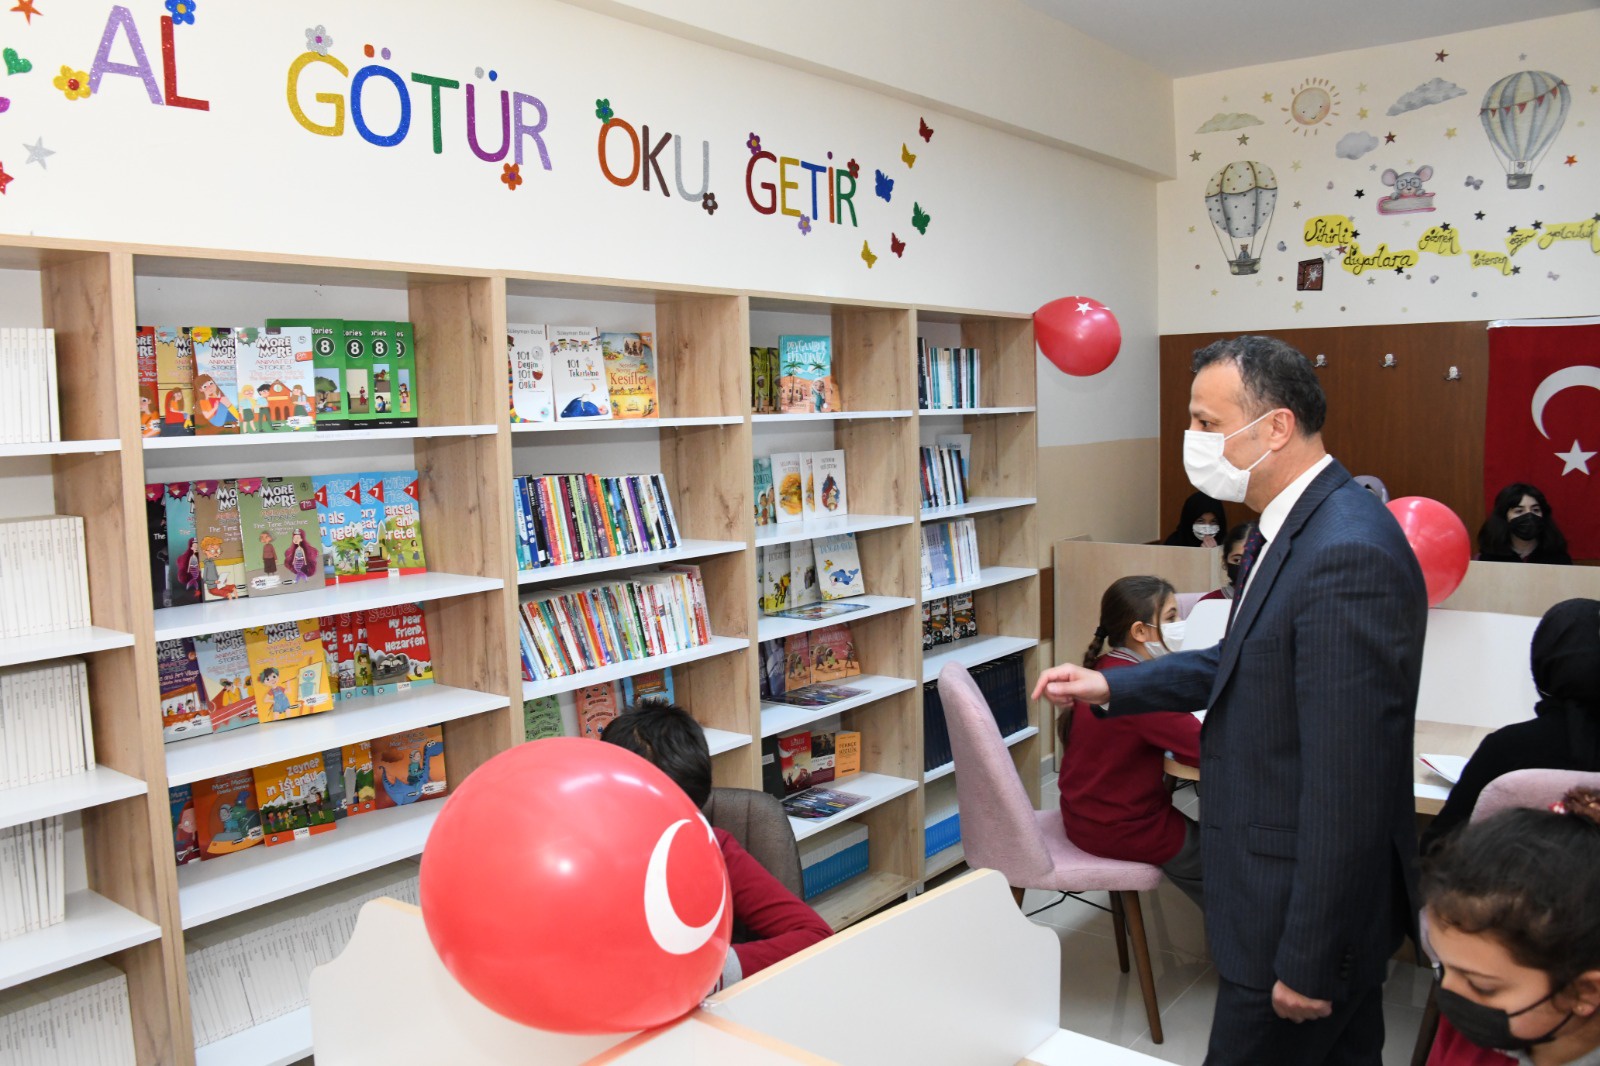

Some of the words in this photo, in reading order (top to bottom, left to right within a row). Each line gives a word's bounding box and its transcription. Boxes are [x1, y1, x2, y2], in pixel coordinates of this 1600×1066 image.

[89, 5, 210, 112] AL
[287, 44, 553, 171] GÖTÜR
[598, 118, 709, 202] OKU
[745, 150, 858, 227] GETİR
[1305, 219, 1349, 244] Sihirli
[256, 336, 291, 348] MORE
[321, 340, 331, 353] 8
[351, 342, 360, 354] 8
[376, 342, 385, 354] 8
[259, 346, 292, 358] MORE
[517, 351, 530, 360] 101
[567, 359, 579, 368] 101
[261, 484, 294, 498] MORE
[350, 490, 356, 499] 7
[373, 487, 379, 497] 7
[407, 486, 414, 495] 7
[263, 494, 297, 510] MORE
[264, 621, 297, 635] MORE
[268, 629, 300, 644] MORE
